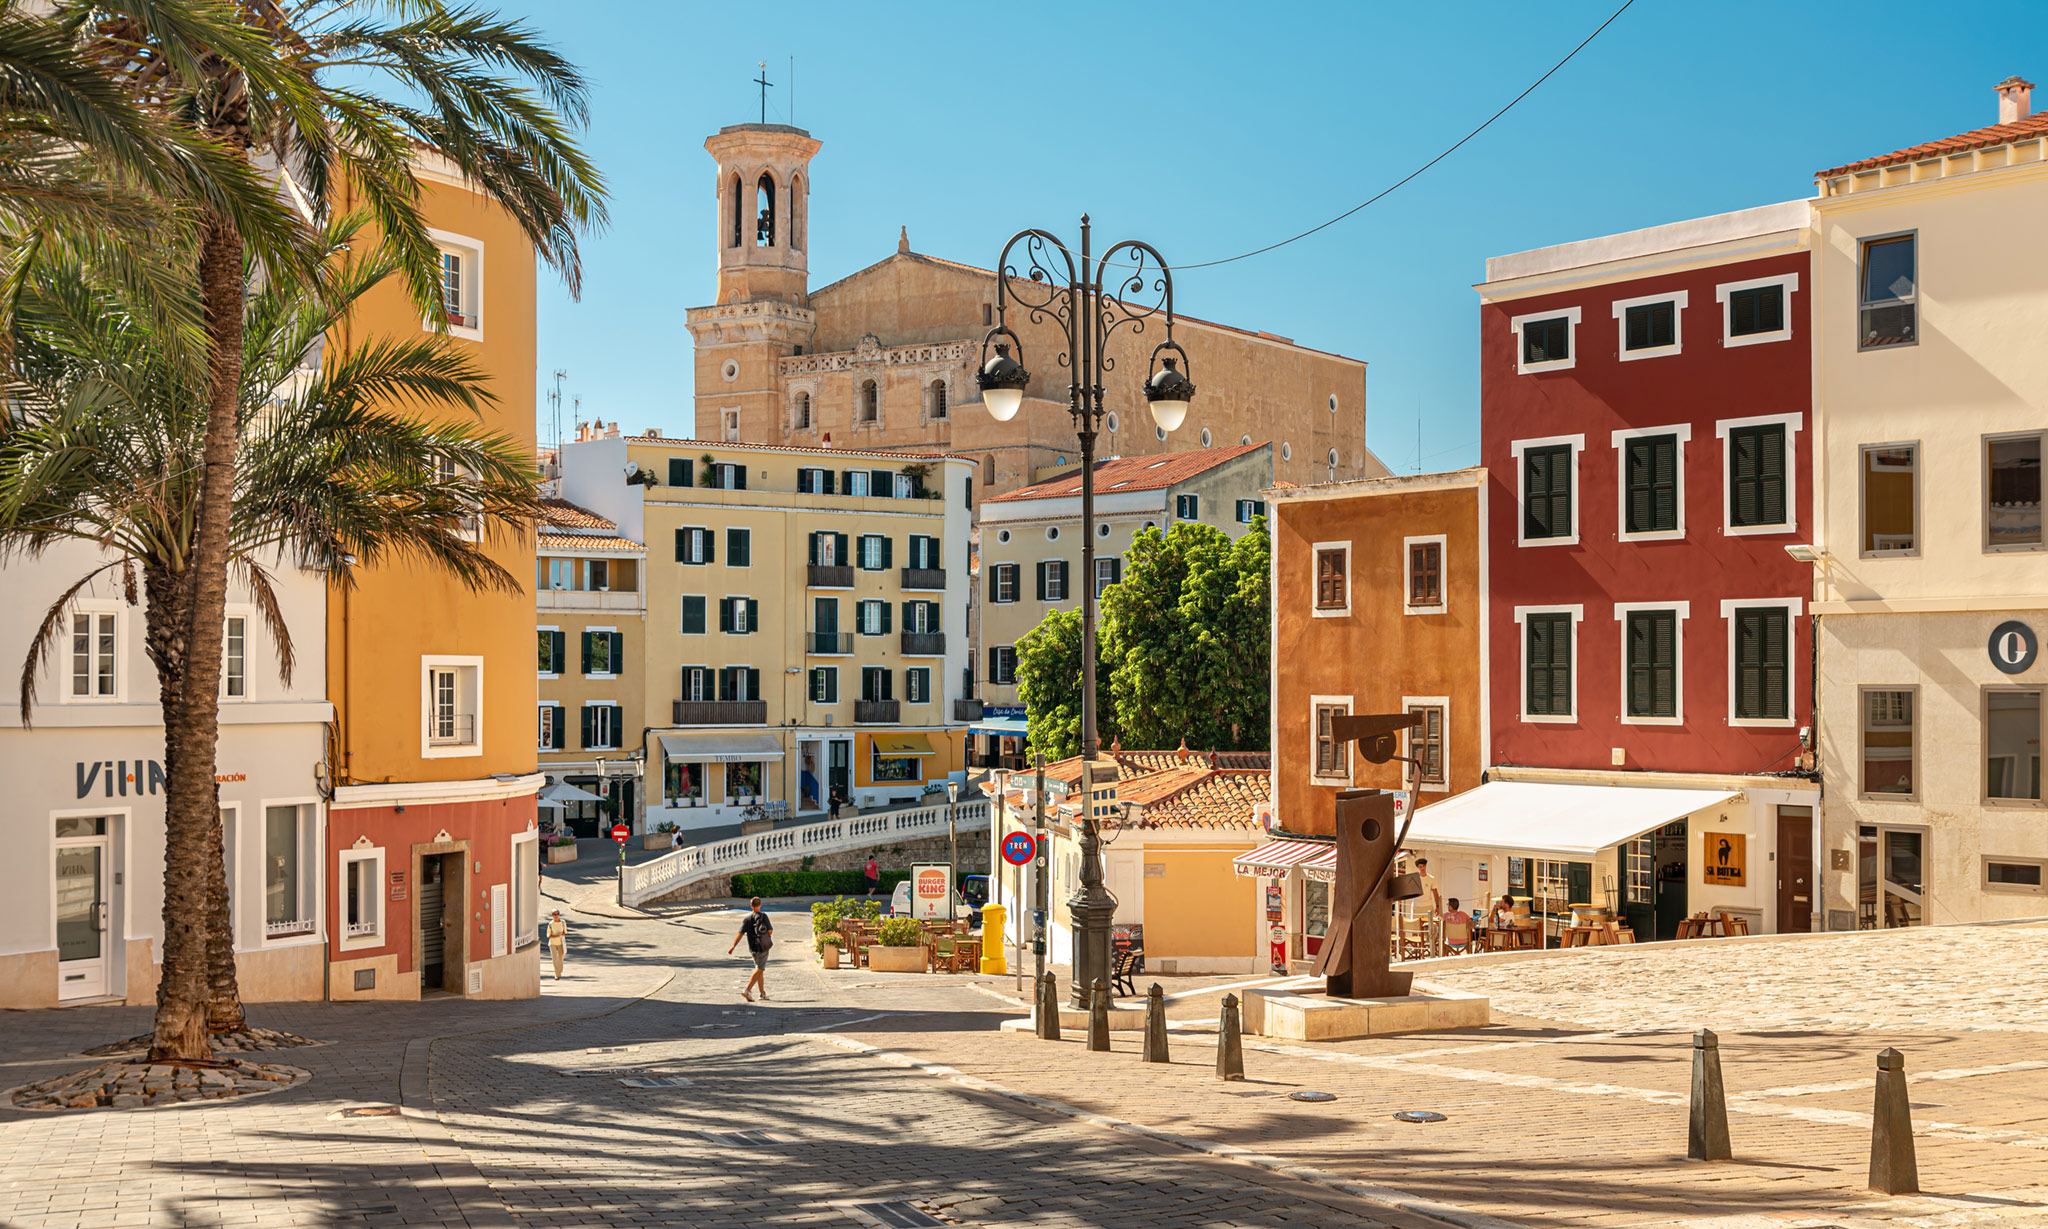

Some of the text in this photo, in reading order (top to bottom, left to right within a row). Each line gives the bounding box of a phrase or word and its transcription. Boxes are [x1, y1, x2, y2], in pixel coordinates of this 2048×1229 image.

[215, 772, 247, 783] RACIÓN
[1785, 792, 1791, 802] 7
[1009, 842, 1028, 850] TREN
[1237, 864, 1286, 878] LA MEJOR
[918, 885, 945, 893] KING
